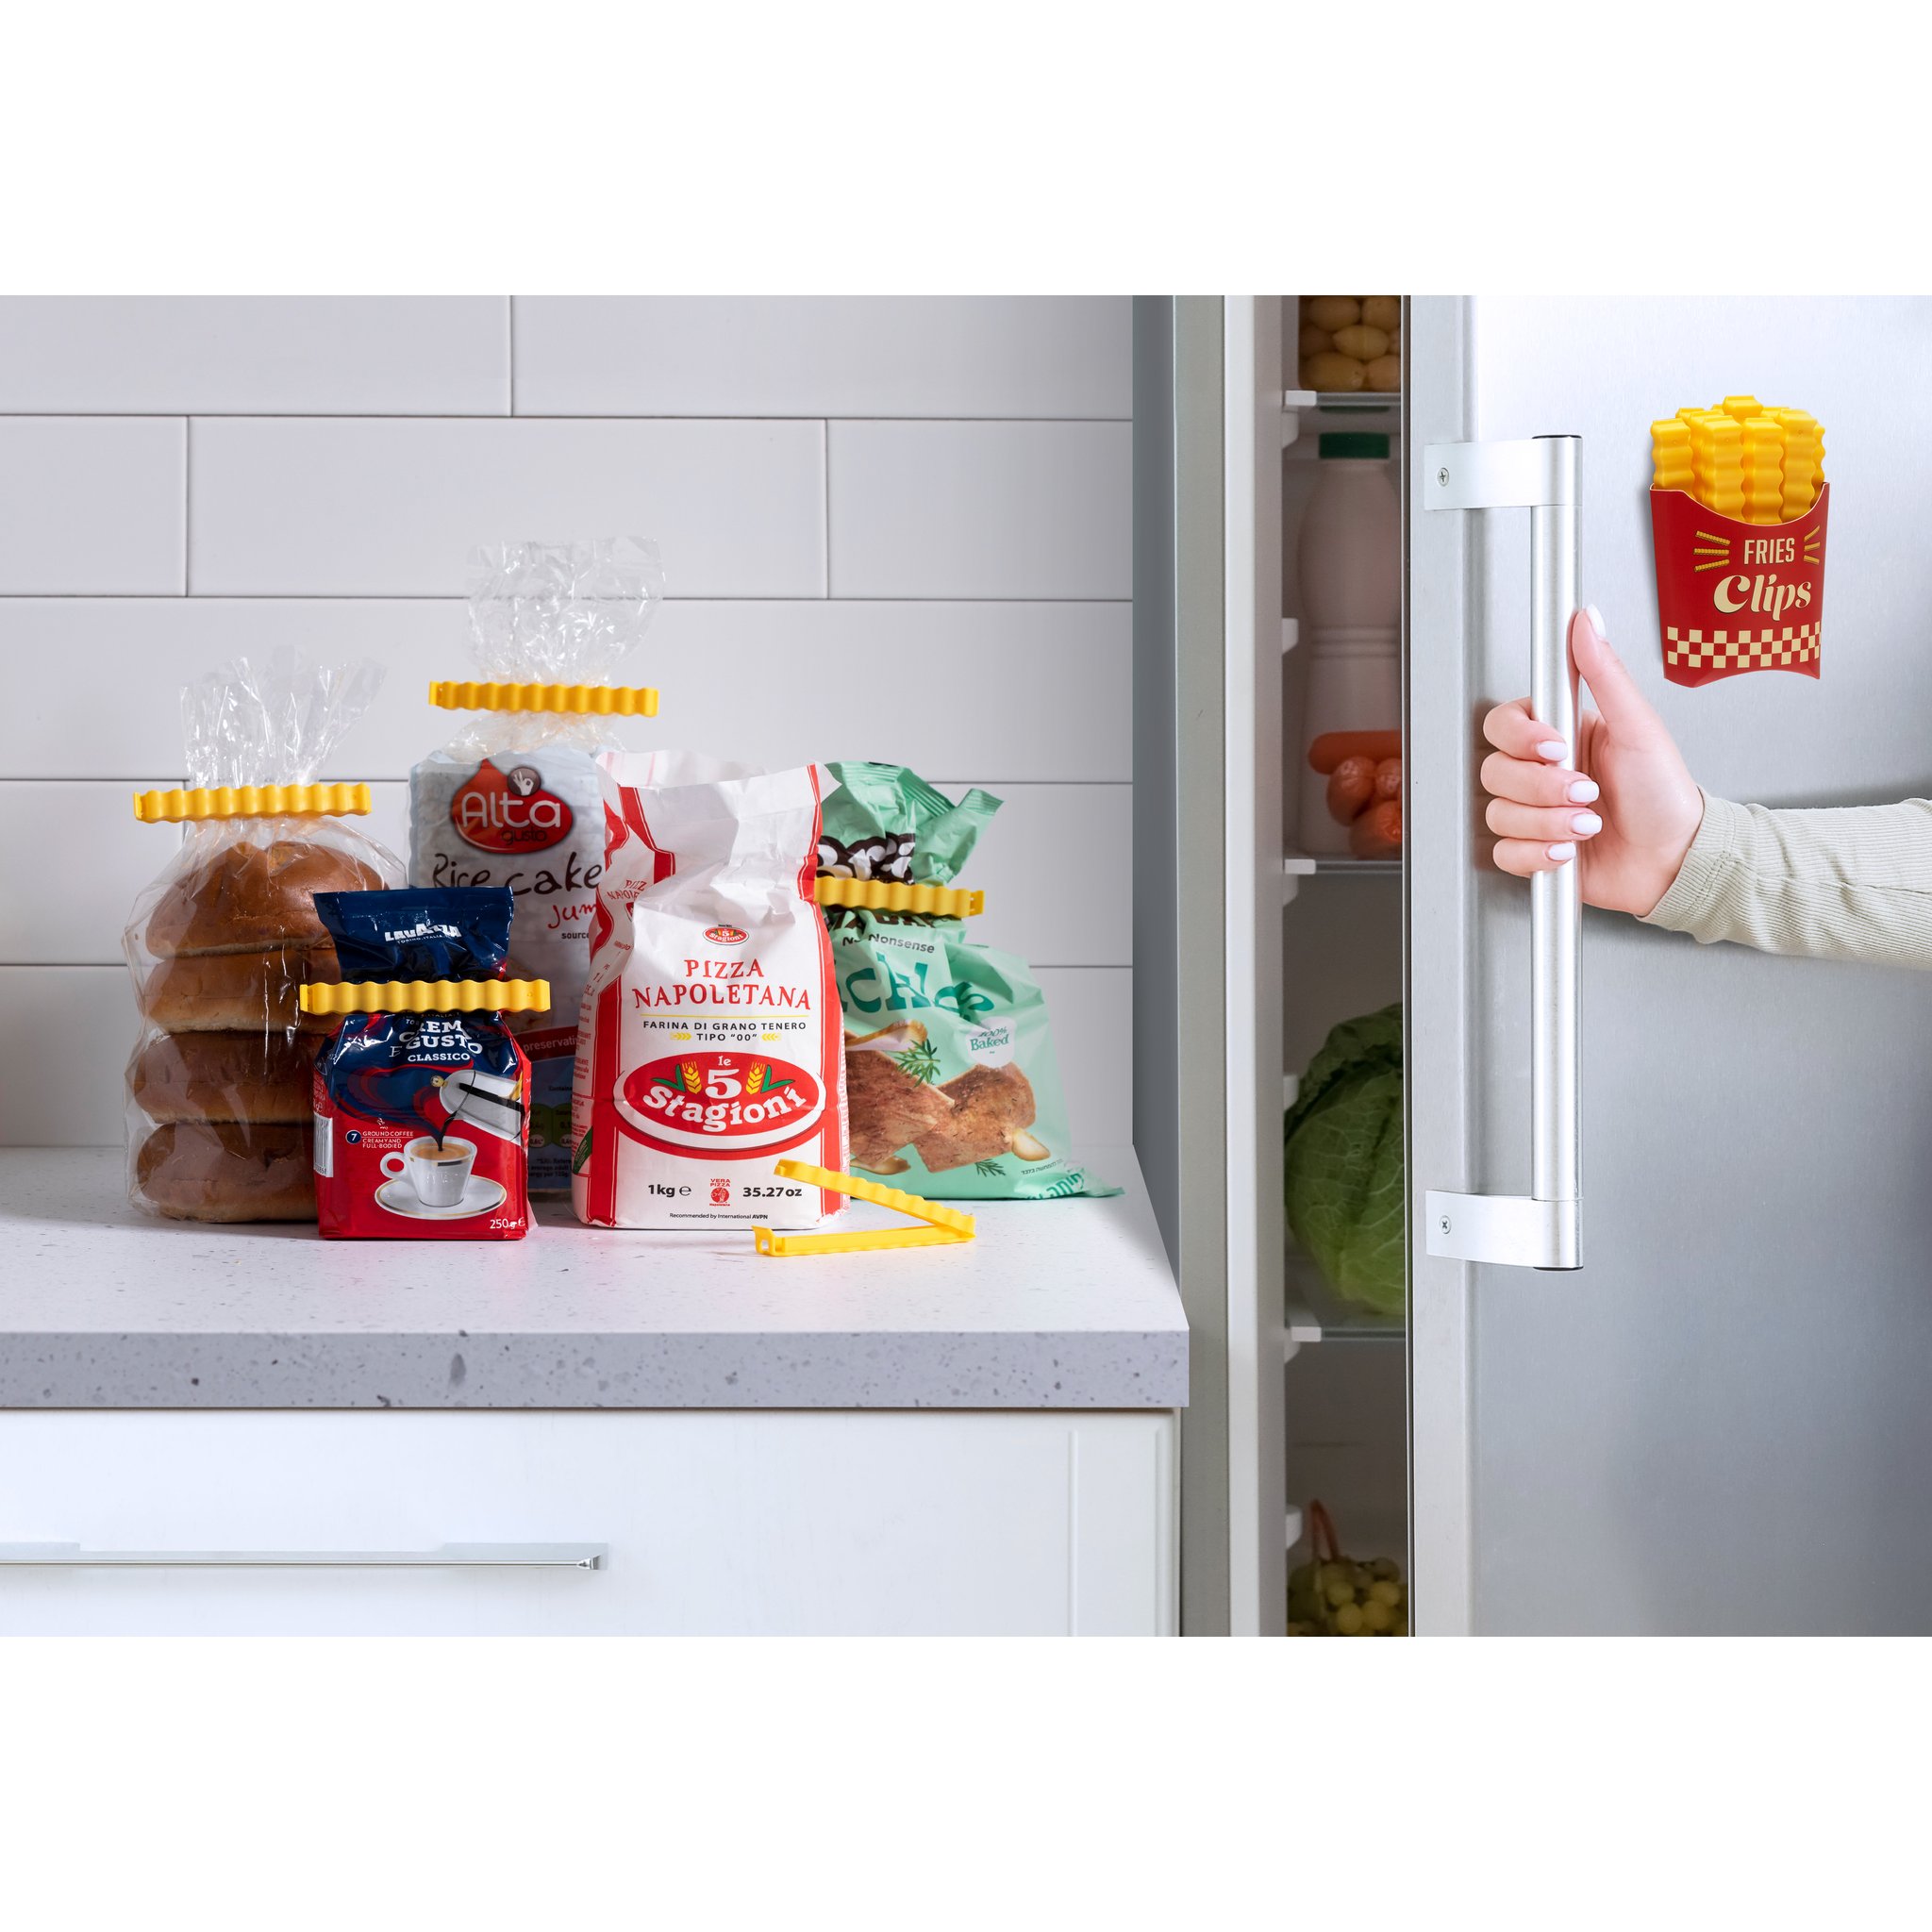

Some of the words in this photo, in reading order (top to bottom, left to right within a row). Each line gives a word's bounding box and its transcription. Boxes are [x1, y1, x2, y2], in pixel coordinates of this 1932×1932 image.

[1743, 538, 1795, 565] FRIES
[1713, 574, 1812, 622] Clips
[461, 791, 561, 828] Alta
[501, 828, 547, 845] gusto
[432, 853, 491, 888] Rice
[869, 933, 935, 954] Nonsense
[684, 958, 765, 979] PIZZA
[632, 983, 811, 1010] NAPOLETANA
[643, 1021, 689, 1030] FARINA
[694, 1022, 708, 1031] DI
[712, 1023, 757, 1031] GRANO
[761, 1022, 807, 1030] TENERO
[406, 1034, 483, 1055] GUSTO
[696, 1033, 726, 1041] TIPO
[970, 1034, 1009, 1052] Baked
[408, 1053, 471, 1062] CLASSICO
[718, 1056, 732, 1067] le
[705, 1069, 742, 1100] 5
[642, 1085, 808, 1132] Stagioni
[351, 1133, 358, 1141] 7
[648, 1184, 675, 1198] 1kg
